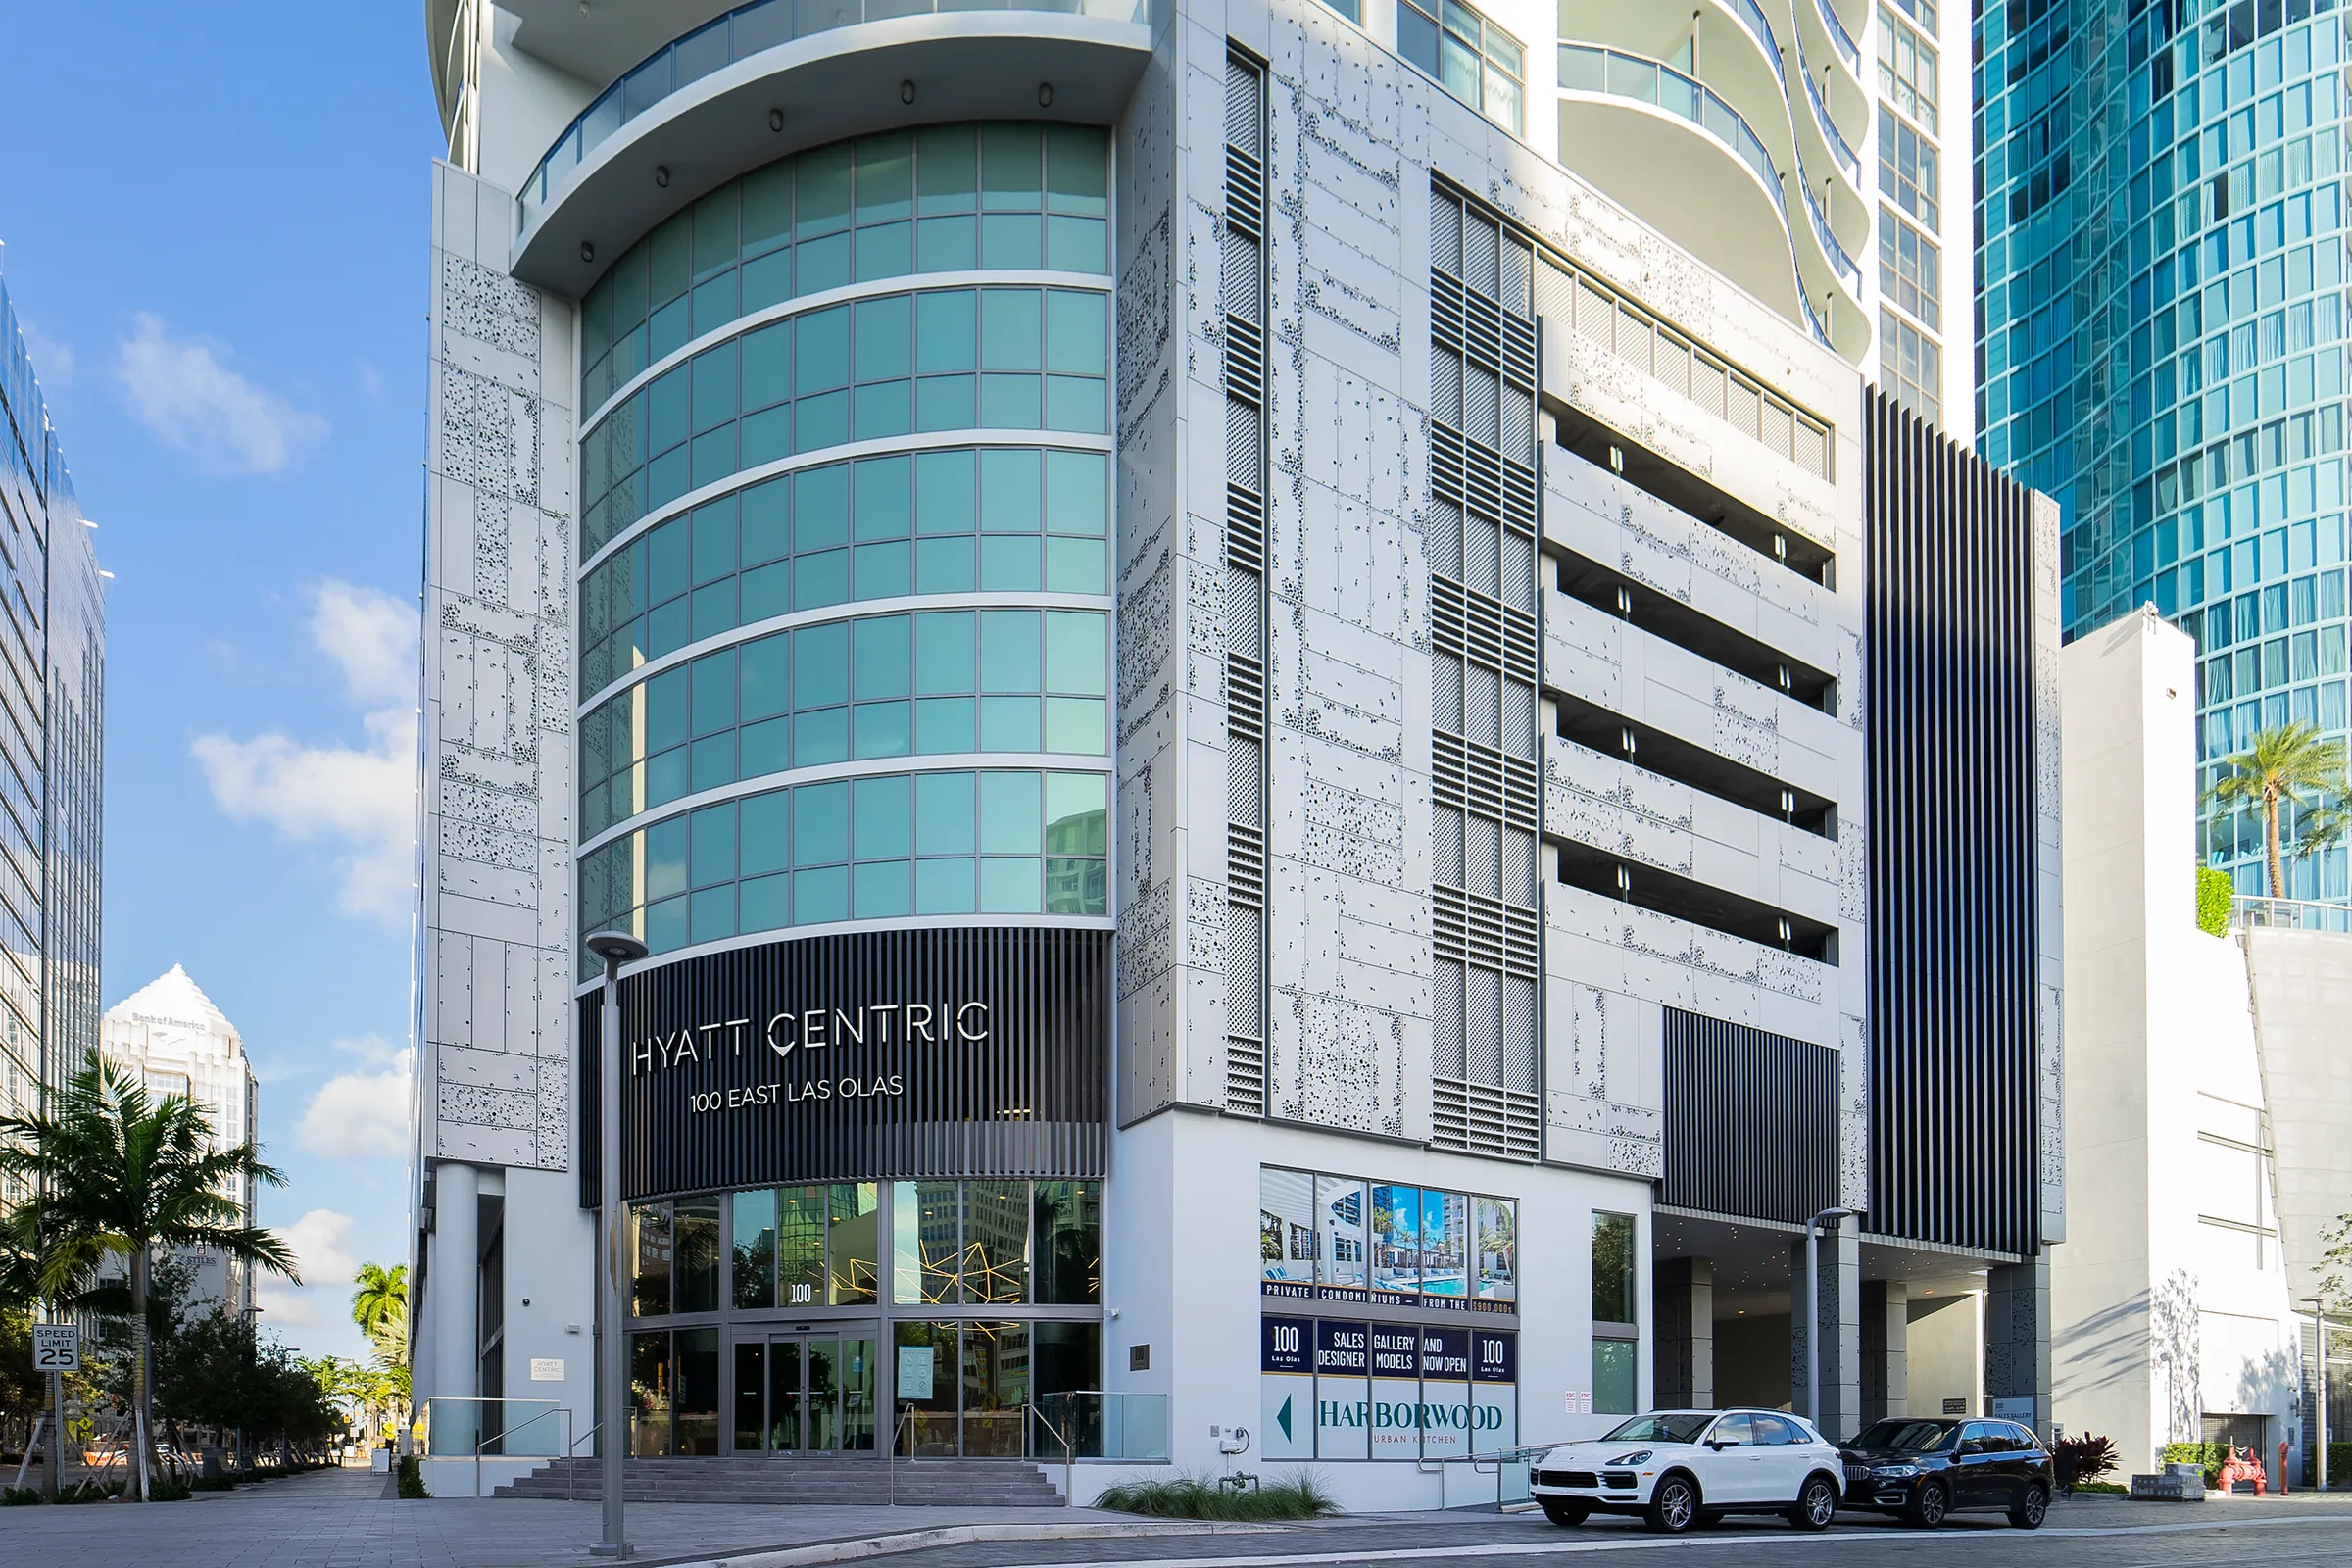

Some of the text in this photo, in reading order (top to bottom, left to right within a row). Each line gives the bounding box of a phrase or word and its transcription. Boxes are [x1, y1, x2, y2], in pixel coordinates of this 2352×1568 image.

[132, 1012, 156, 1024] Bank
[168, 1017, 206, 1031] America
[633, 1002, 989, 1076] HYATT CENTRIC
[690, 1075, 904, 1113] 100 EAST LAS OLAS
[187, 1255, 217, 1265] STILES
[791, 1283, 811, 1303] 100
[1266, 1284, 1310, 1298] PRIVATE
[1423, 1298, 1446, 1309] FROM
[1449, 1299, 1466, 1310] THE
[36, 1329, 75, 1338] SPEED
[41, 1339, 71, 1348] LIMIT
[1274, 1325, 1299, 1353] 100
[1334, 1332, 1443, 1353] SALES GALLERY AND
[40, 1348, 74, 1365] 25
[1318, 1349, 1467, 1373] DESIGNER MODELS NOW OPEN
[1482, 1339, 1503, 1364] 100
[1319, 1400, 1502, 1431] HARBORWOOD
[1374, 1434, 1407, 1443] URBAN
